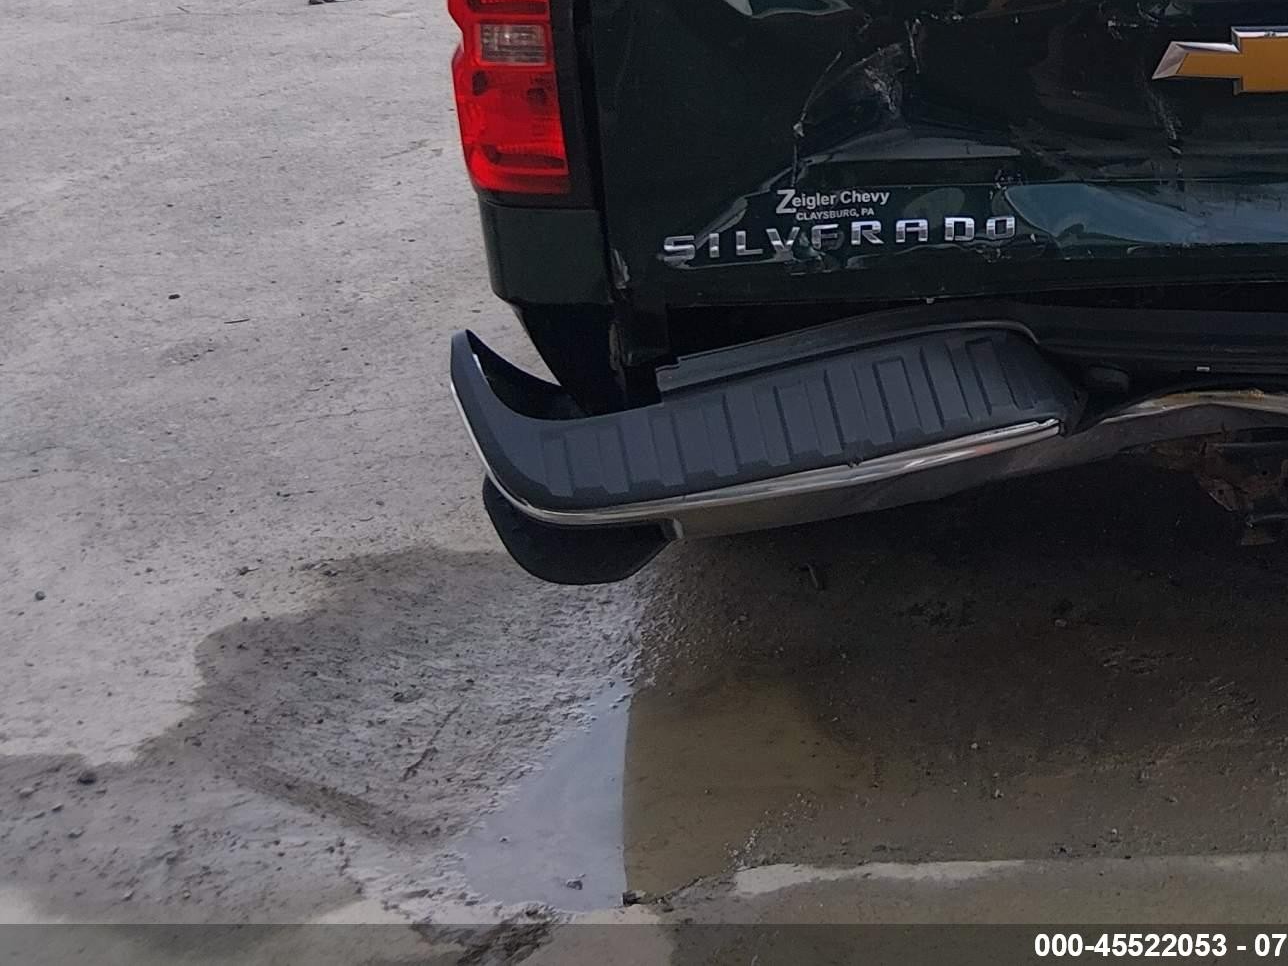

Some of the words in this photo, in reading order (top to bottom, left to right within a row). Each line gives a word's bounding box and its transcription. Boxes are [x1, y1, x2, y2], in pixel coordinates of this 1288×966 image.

[776, 189, 836, 214] Zeigler
[839, 189, 891, 209] Chevy
[795, 208, 859, 221] CLAYSBURG,
[860, 206, 875, 217] PA
